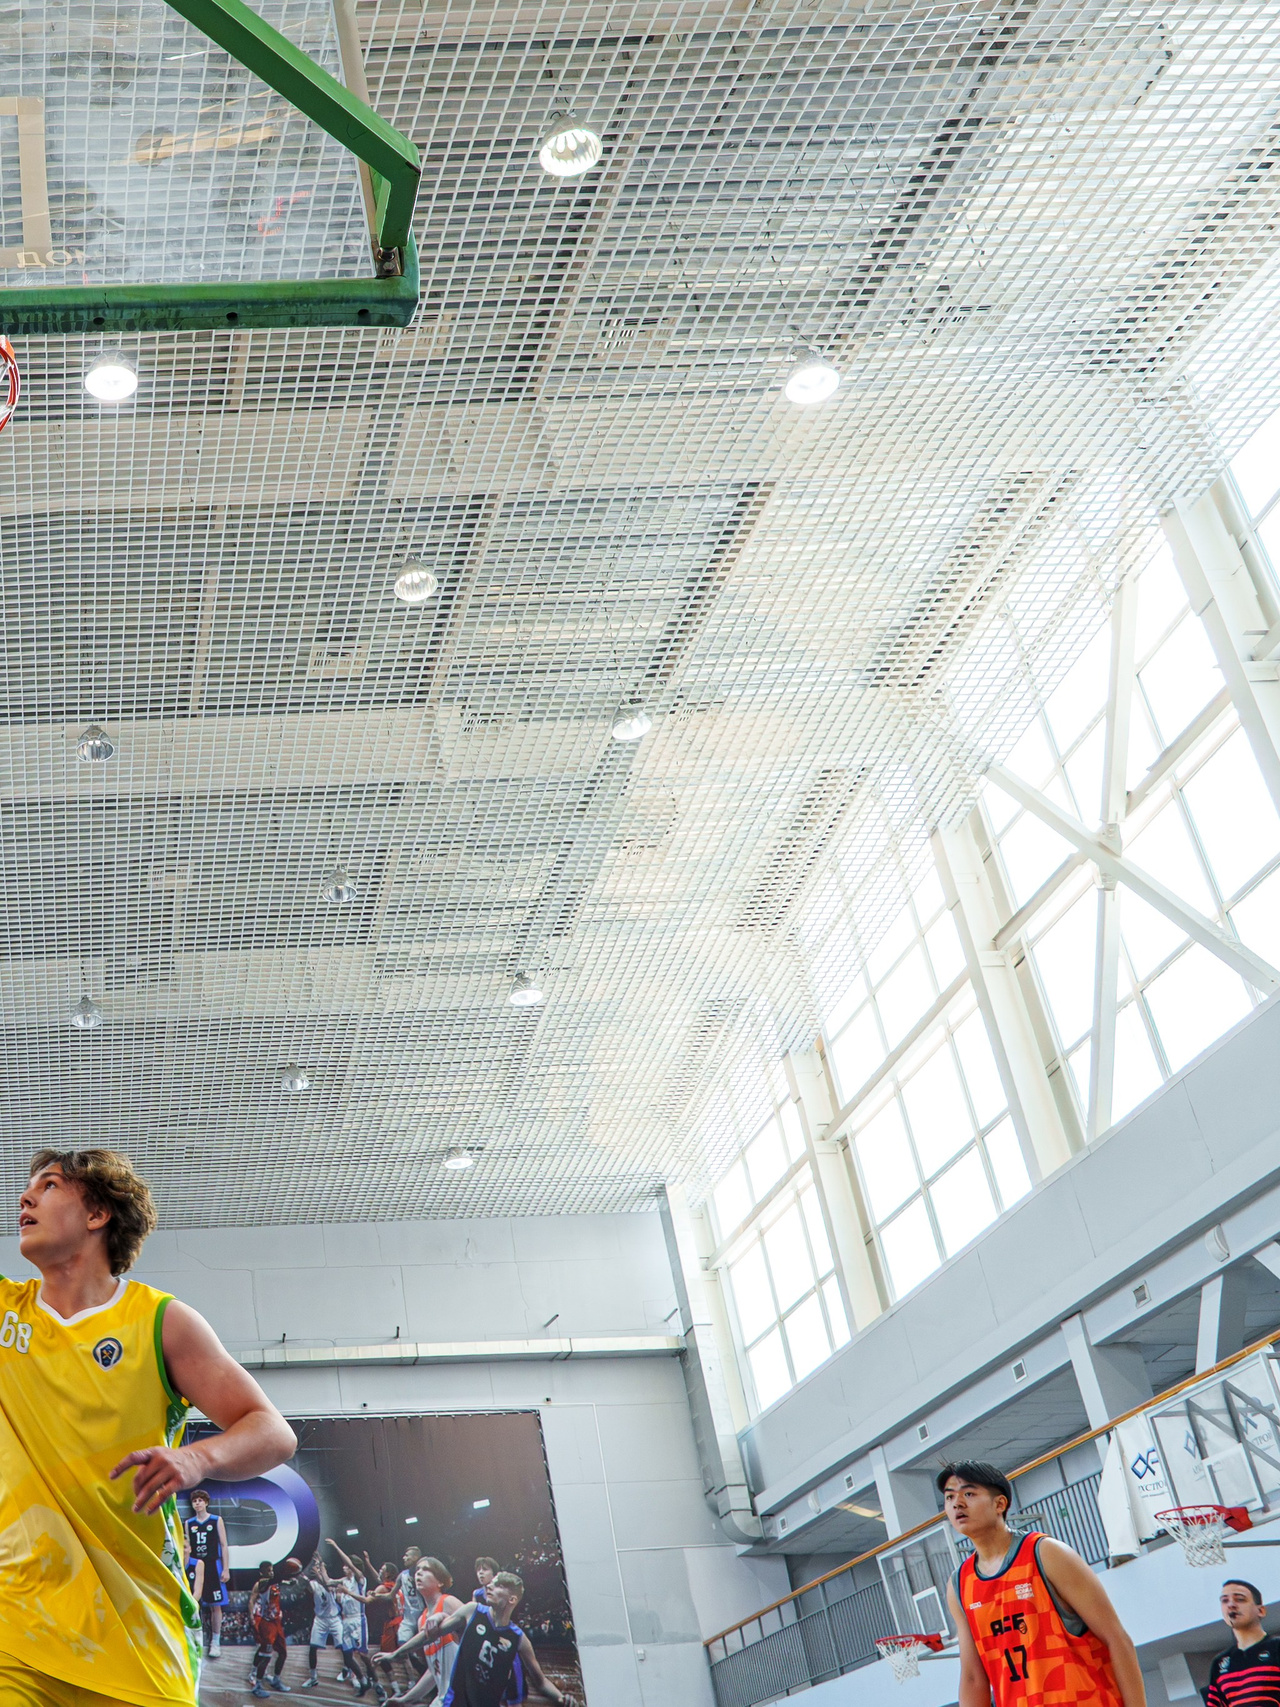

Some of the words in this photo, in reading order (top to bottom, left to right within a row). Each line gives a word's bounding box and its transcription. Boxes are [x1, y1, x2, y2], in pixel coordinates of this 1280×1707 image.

[196, 1532, 207, 1544] 15
[213, 1590, 222, 1601] 15
[1004, 1645, 1029, 1682] 17
